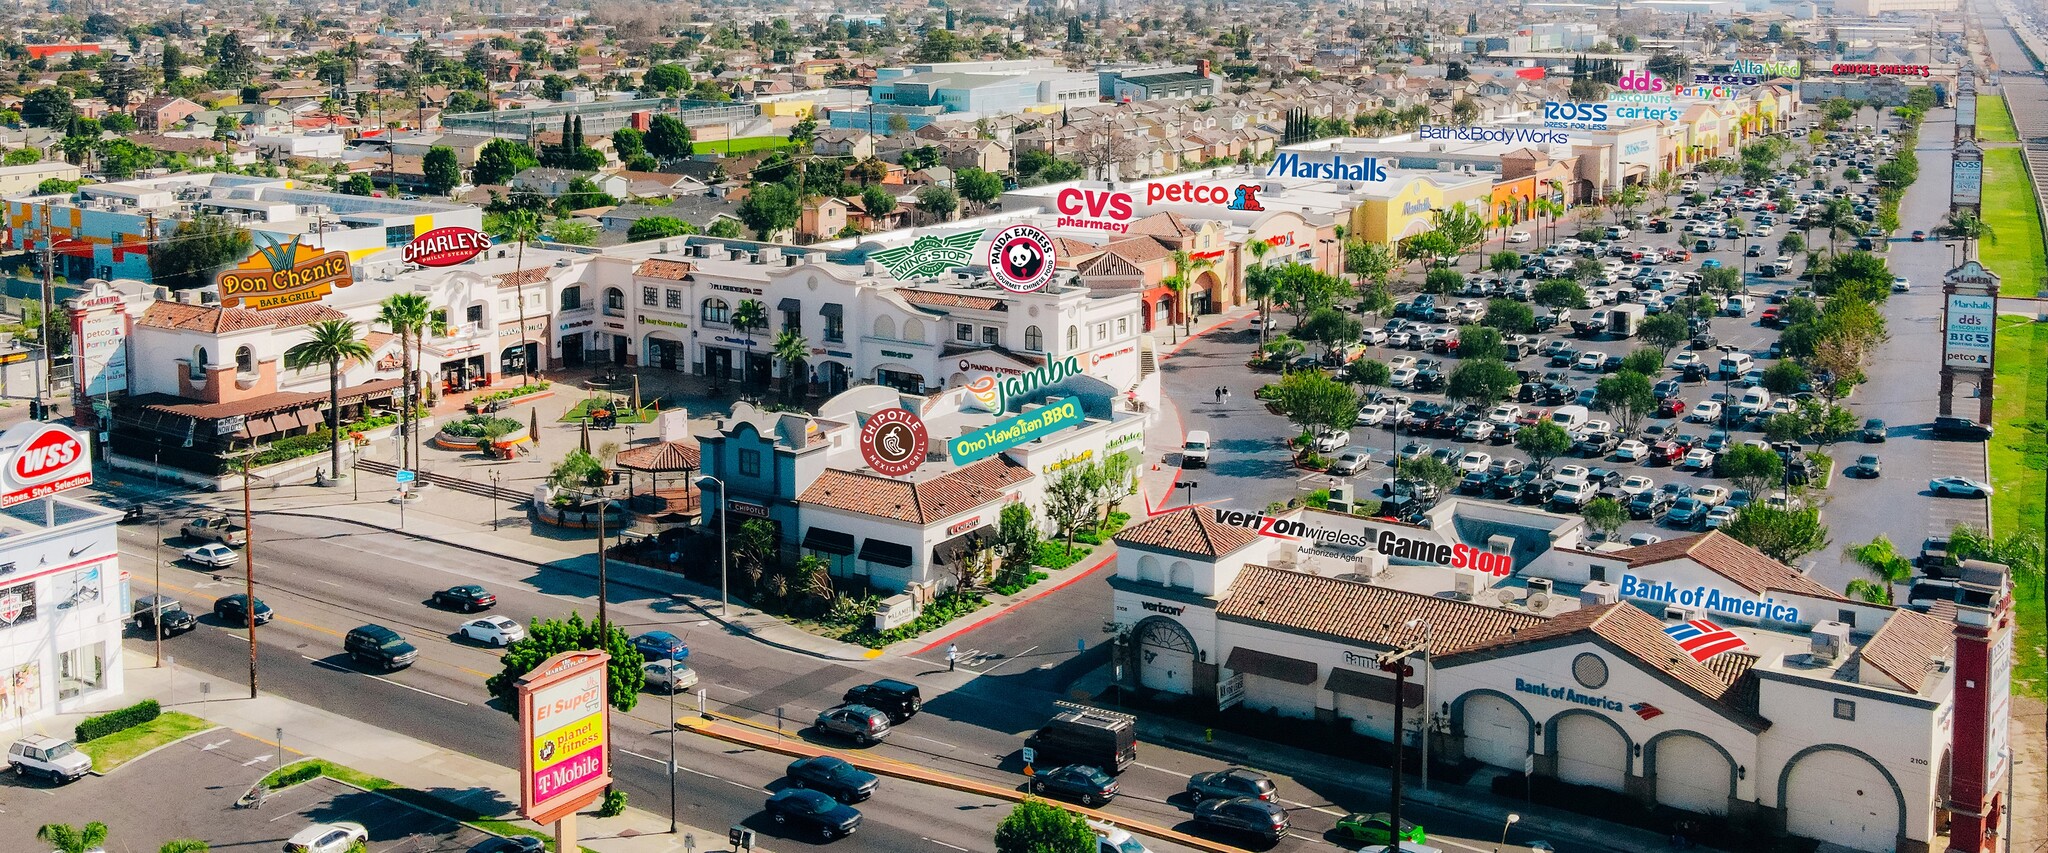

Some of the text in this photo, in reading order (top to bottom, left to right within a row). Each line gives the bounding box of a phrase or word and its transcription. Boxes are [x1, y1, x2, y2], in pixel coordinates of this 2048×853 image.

[1951, 300, 1991, 310] Marshalls
[86, 329, 111, 340] petco
[1950, 333, 1989, 343] BIG 5
[1947, 352, 1976, 361] petco
[970, 363, 994, 373] PANDA
[24, 440, 76, 474] WSS
[3, 476, 91, 505] Shoes. Style. Selection.
[734, 504, 766, 516] CHIPOTLE
[1141, 601, 1181, 616] verizon
[1515, 677, 1623, 713] Bank of America
[537, 689, 597, 721] El Super
[557, 722, 592, 749] planet
[562, 732, 599, 755] fitness
[1911, 757, 1929, 767] 2100
[552, 756, 600, 790] Mobile
